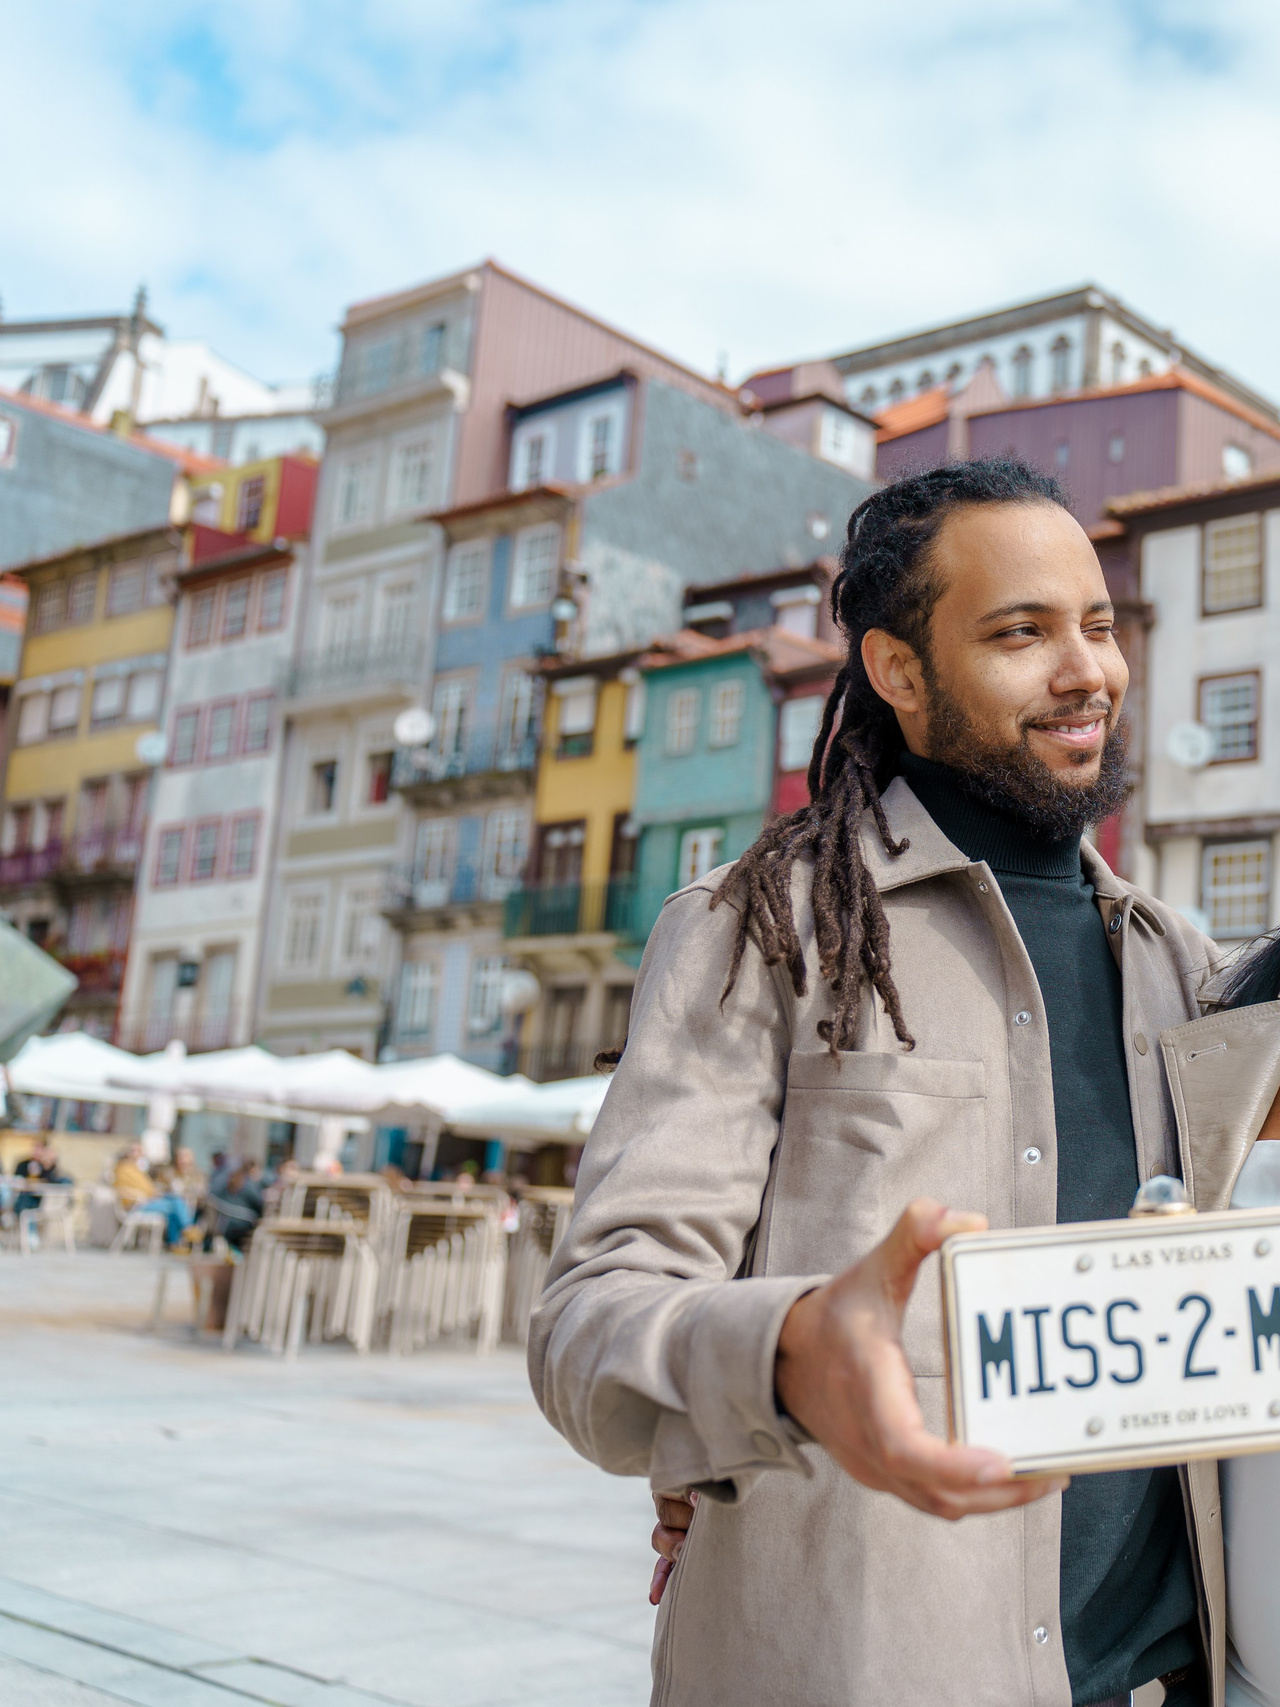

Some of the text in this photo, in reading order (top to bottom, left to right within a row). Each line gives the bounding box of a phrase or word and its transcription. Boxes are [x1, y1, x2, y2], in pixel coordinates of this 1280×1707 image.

[1111, 1243, 1233, 1270] LAS VEGAS
[1120, 1402, 1251, 1432] STATE OF LOVE
